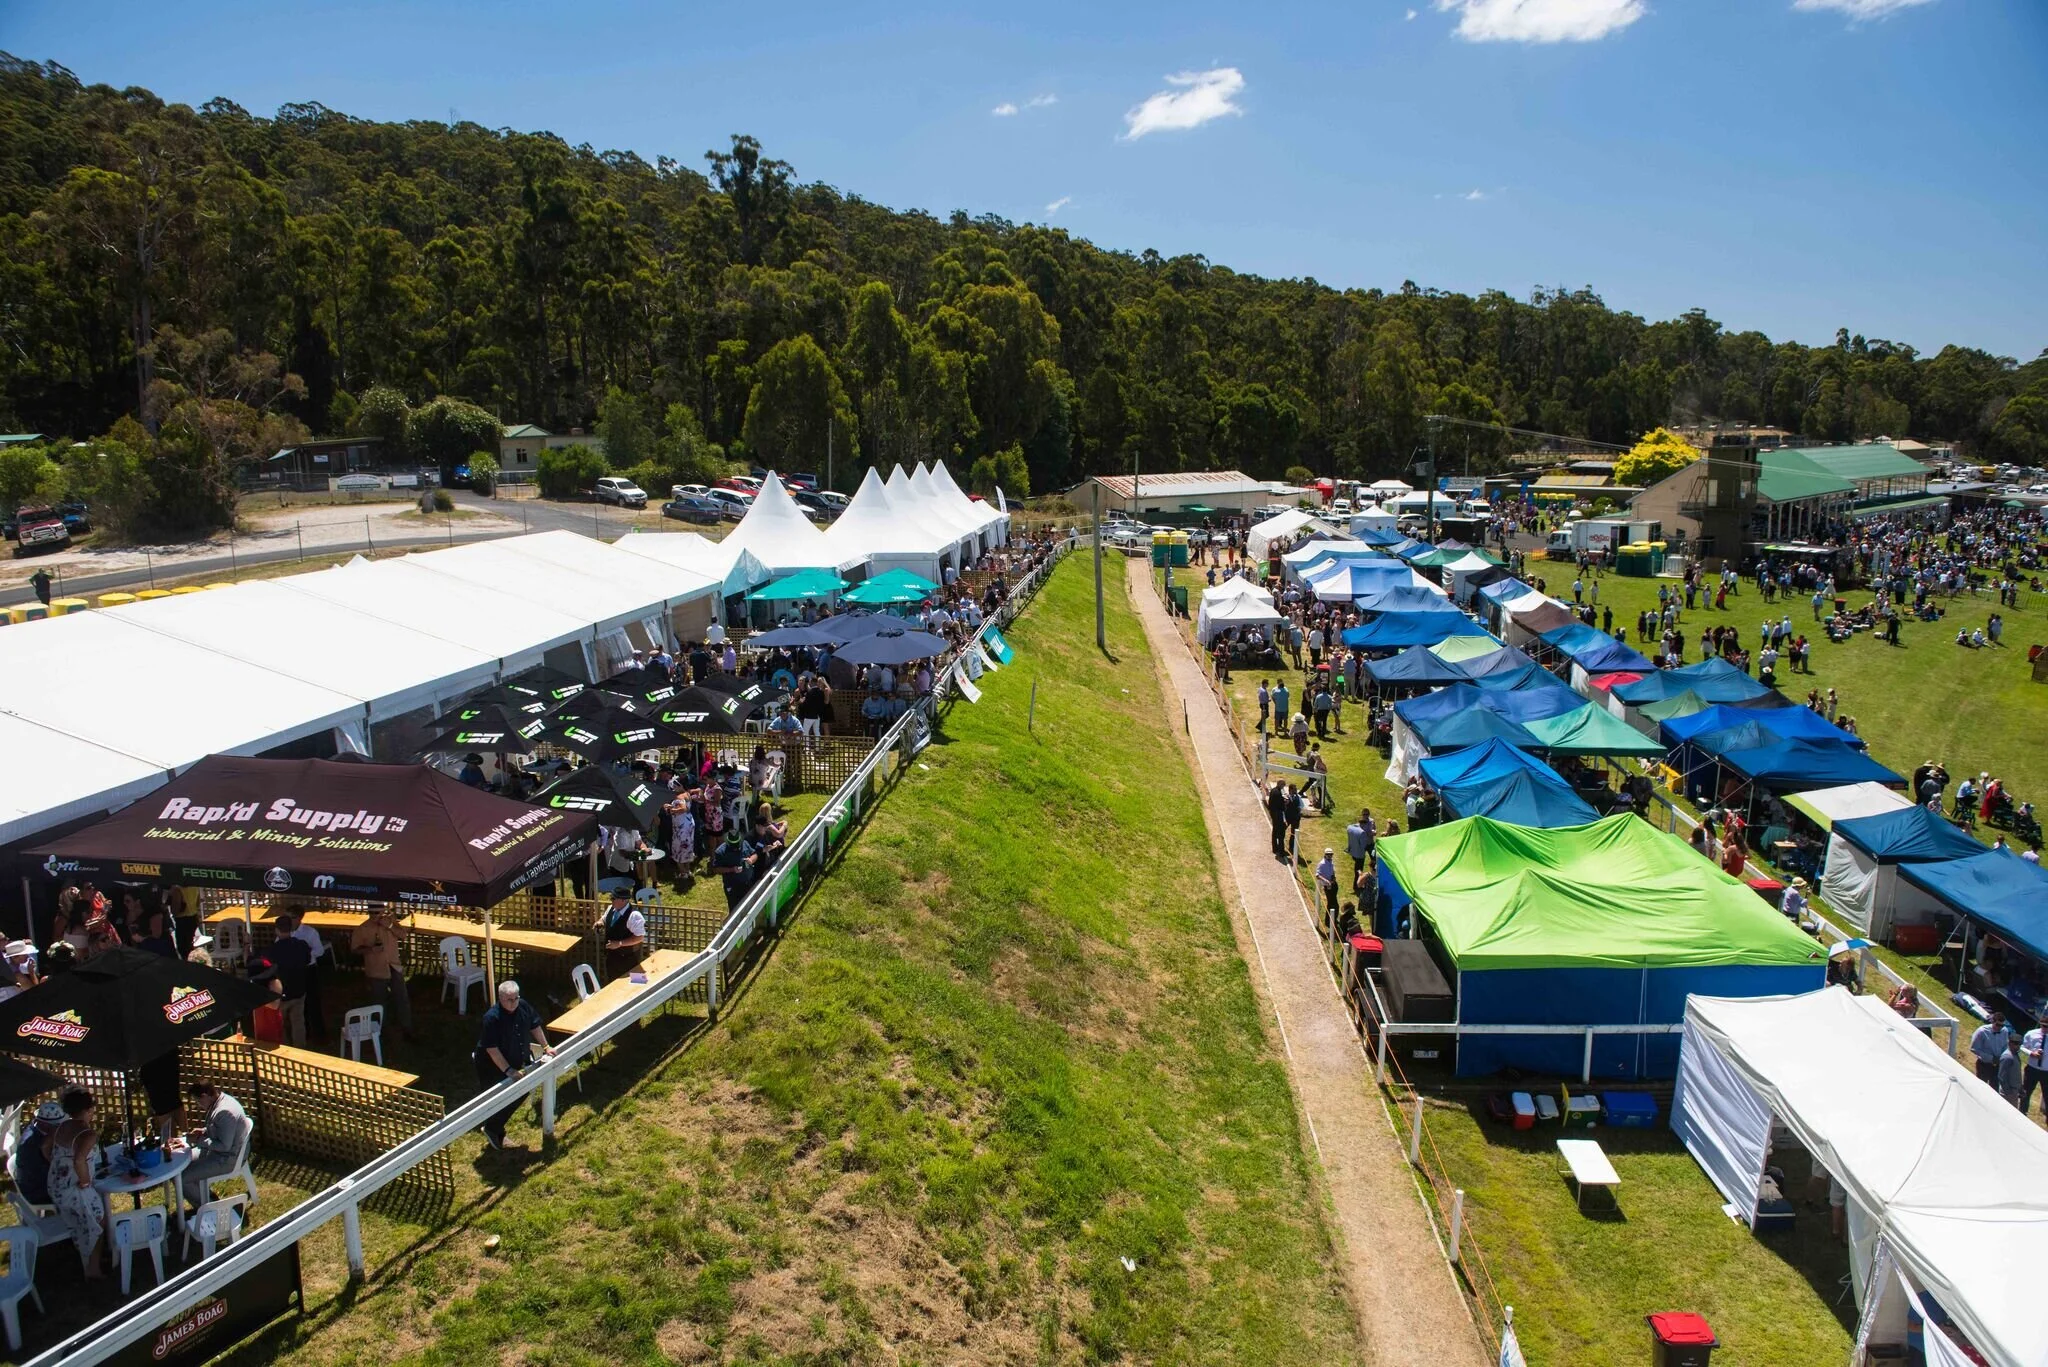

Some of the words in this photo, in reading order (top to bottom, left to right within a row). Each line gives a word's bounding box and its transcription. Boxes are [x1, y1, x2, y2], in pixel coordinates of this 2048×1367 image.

[662, 711, 710, 723] UBET
[455, 732, 505, 744] UBET
[564, 726, 599, 745] UBET
[614, 727, 656, 744] UBET
[550, 795, 612, 811] UBET
[264, 798, 386, 834] Supply
[388, 816, 409, 827] Pty
[504, 808, 549, 830] Supply
[384, 822, 404, 833] Ltd
[143, 827, 225, 841] Industrial
[226, 829, 247, 840] &
[248, 828, 313, 849] Mining
[313, 836, 393, 852] Solutions
[182, 867, 243, 881] FESTOOL
[398, 891, 458, 903] applied
[169, 1000, 194, 1020] JAMES
[191, 990, 212, 1005] BOAG
[21, 1018, 60, 1034] JAMES
[59, 1025, 85, 1038] BOAG
[155, 1320, 195, 1355] JAMES
[197, 1303, 223, 1325] BOAG
